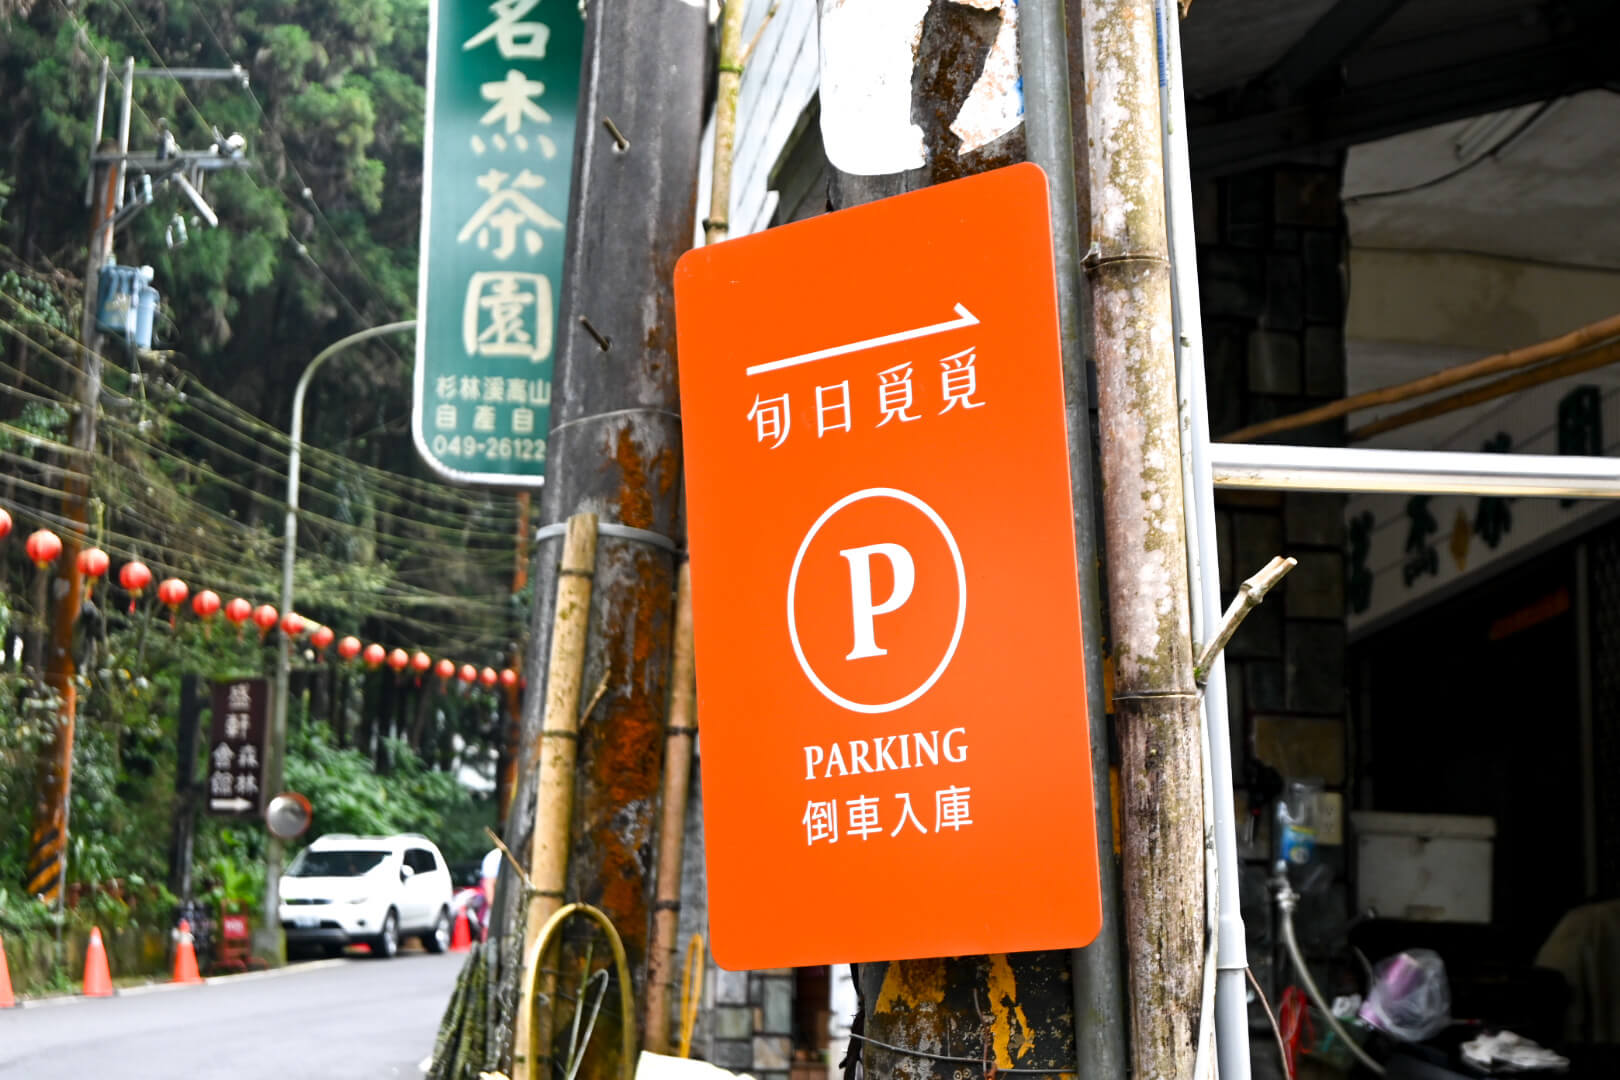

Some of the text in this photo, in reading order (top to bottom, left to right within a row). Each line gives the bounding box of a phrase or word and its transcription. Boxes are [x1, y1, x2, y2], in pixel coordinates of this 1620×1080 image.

[746, 346, 986, 450] 旬日覓覓
[839, 542, 915, 661] P
[803, 727, 969, 780] PARKING
[802, 785, 974, 846] 倒車入庫
